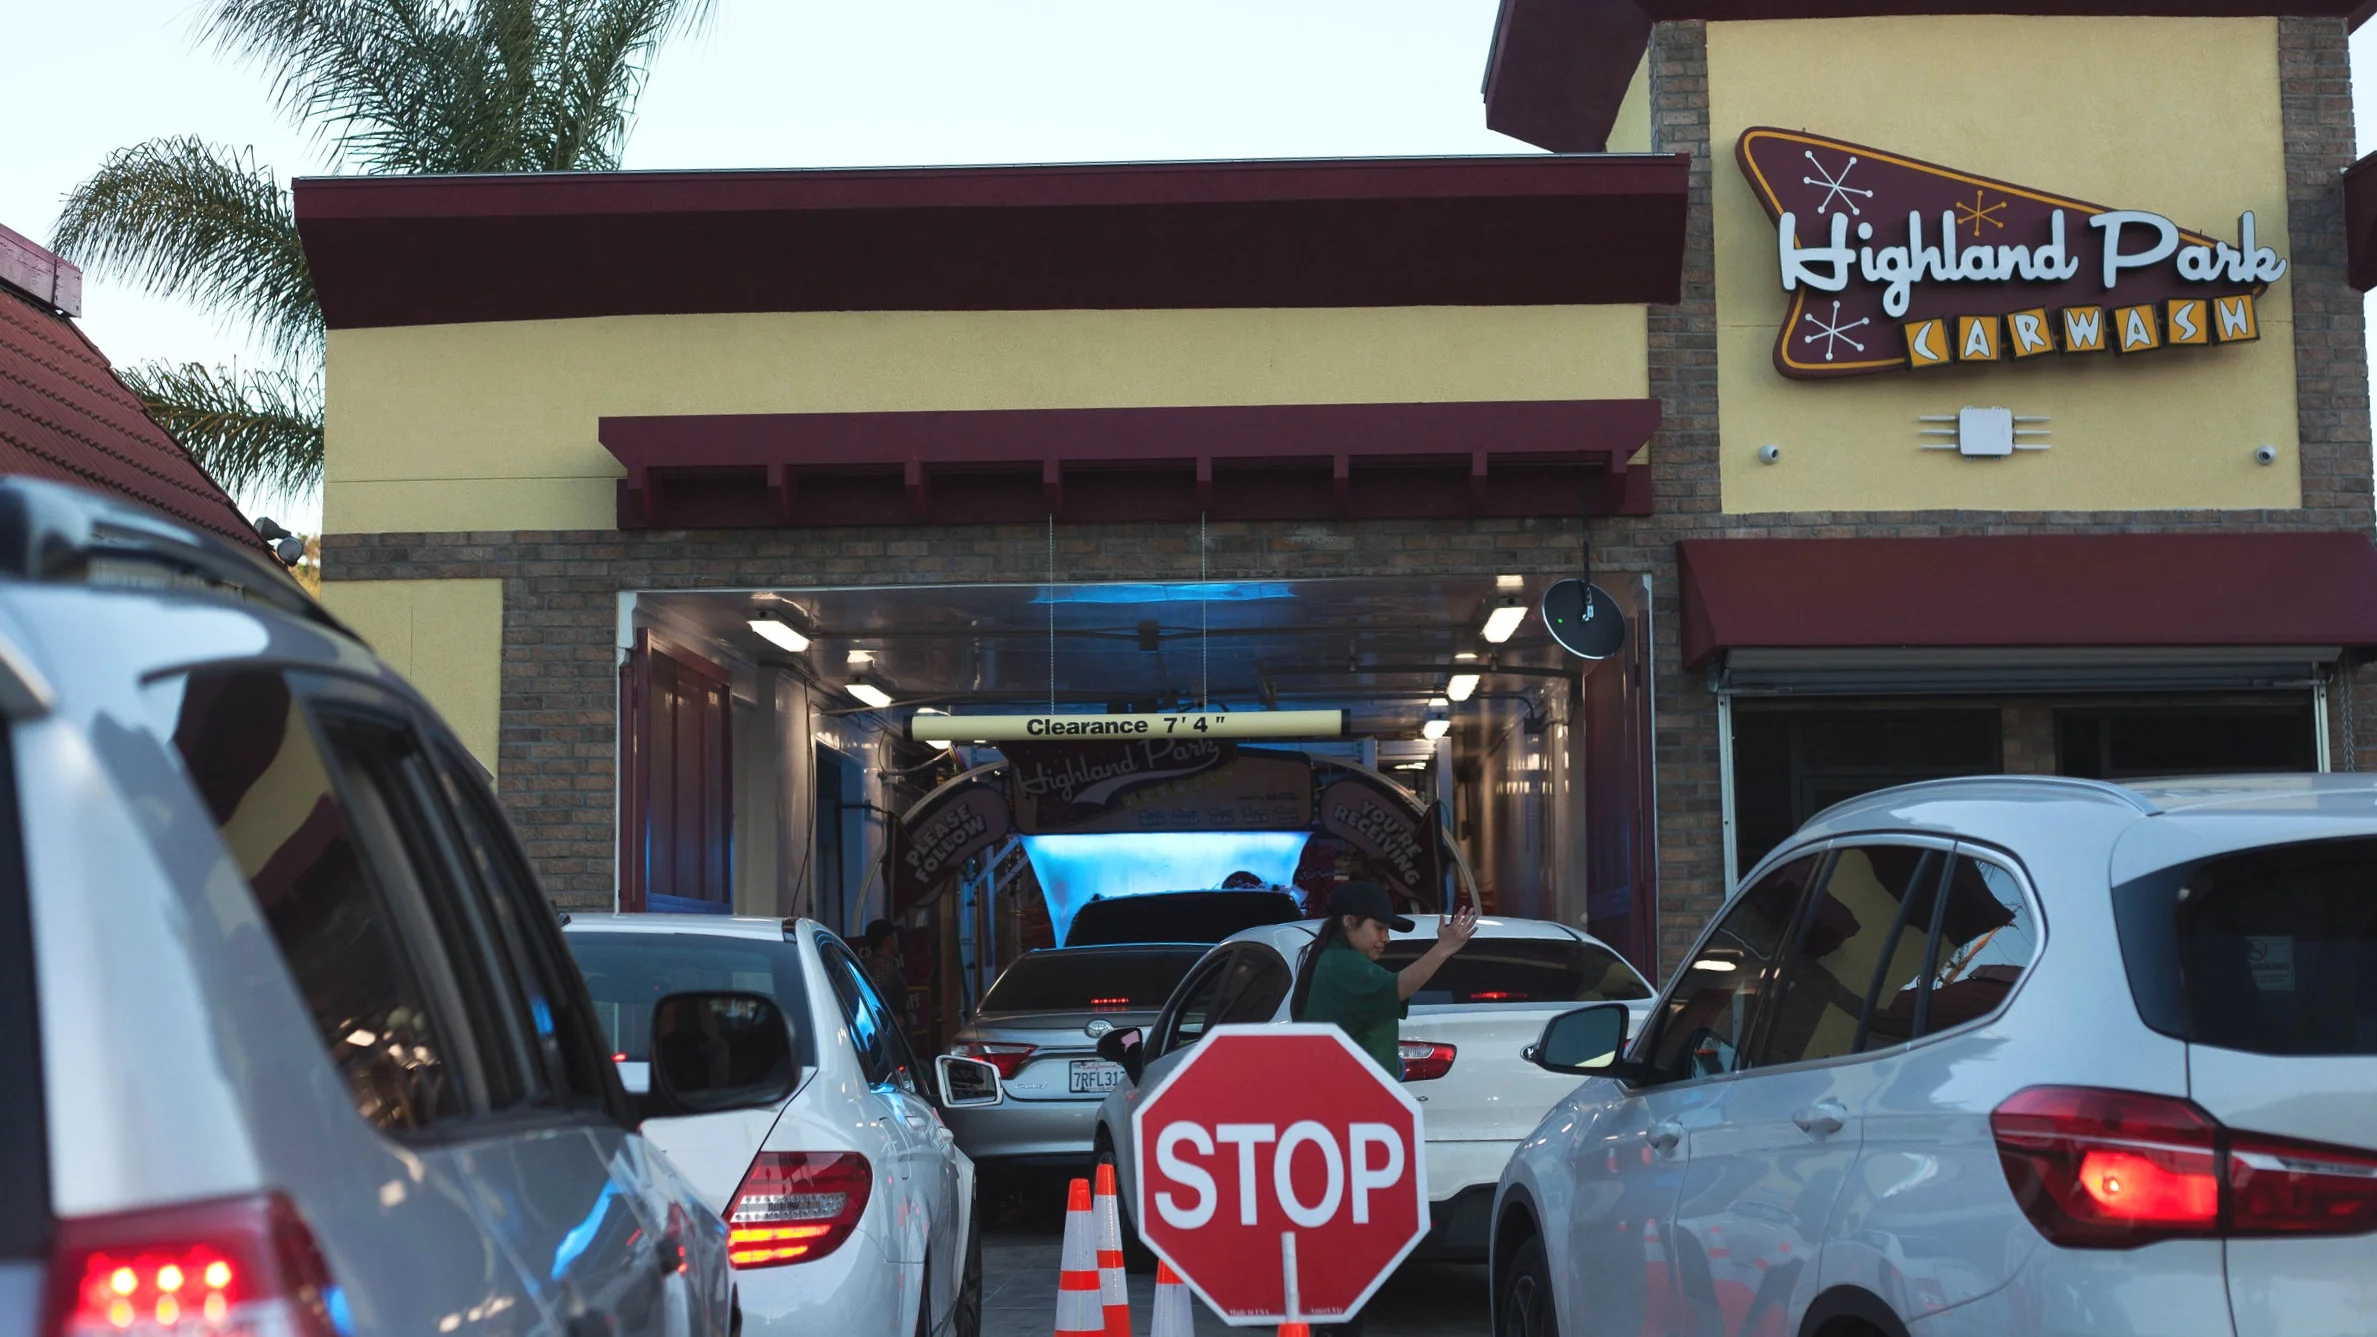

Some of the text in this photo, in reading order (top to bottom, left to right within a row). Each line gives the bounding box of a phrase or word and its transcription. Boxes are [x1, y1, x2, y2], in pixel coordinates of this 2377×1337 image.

[1778, 208, 2288, 318] Highland Park
[1027, 718, 1149, 736] Clearance
[1015, 736, 1221, 801] Highland Park
[905, 802, 971, 867] PLEASE
[914, 815, 986, 884] FOLLOW
[1334, 804, 1421, 885] RECEIVING
[1361, 800, 1423, 860] YOU'RE
[1073, 1071, 1126, 1088] 7RFL31
[1154, 1119, 1405, 1230] STOP
